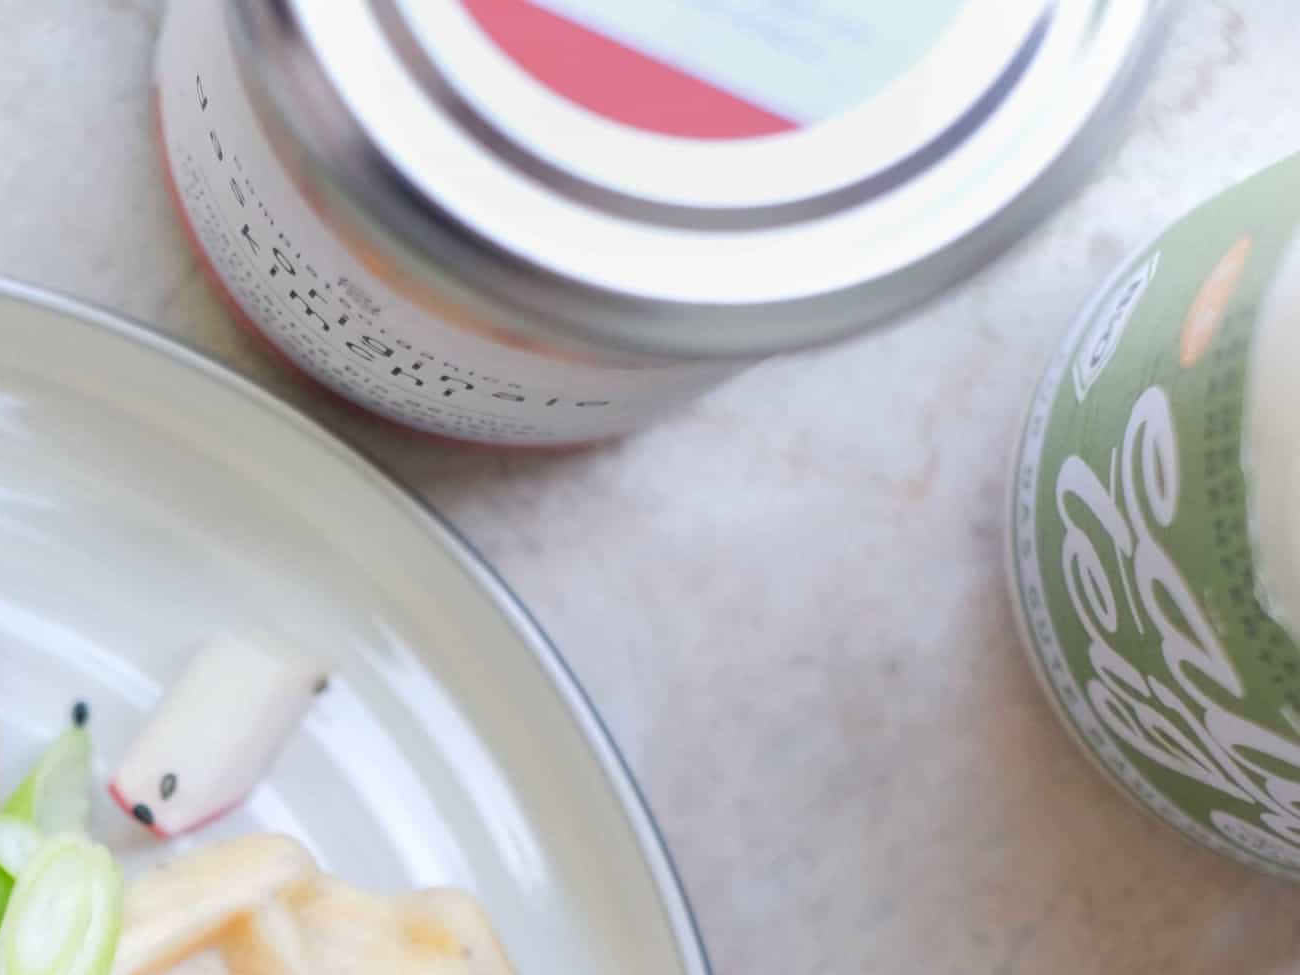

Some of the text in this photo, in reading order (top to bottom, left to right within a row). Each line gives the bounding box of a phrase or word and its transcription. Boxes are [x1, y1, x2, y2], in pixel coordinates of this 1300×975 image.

[195, 73, 246, 208] das
[271, 246, 612, 408] originale
[241, 223, 453, 398] kimchi
